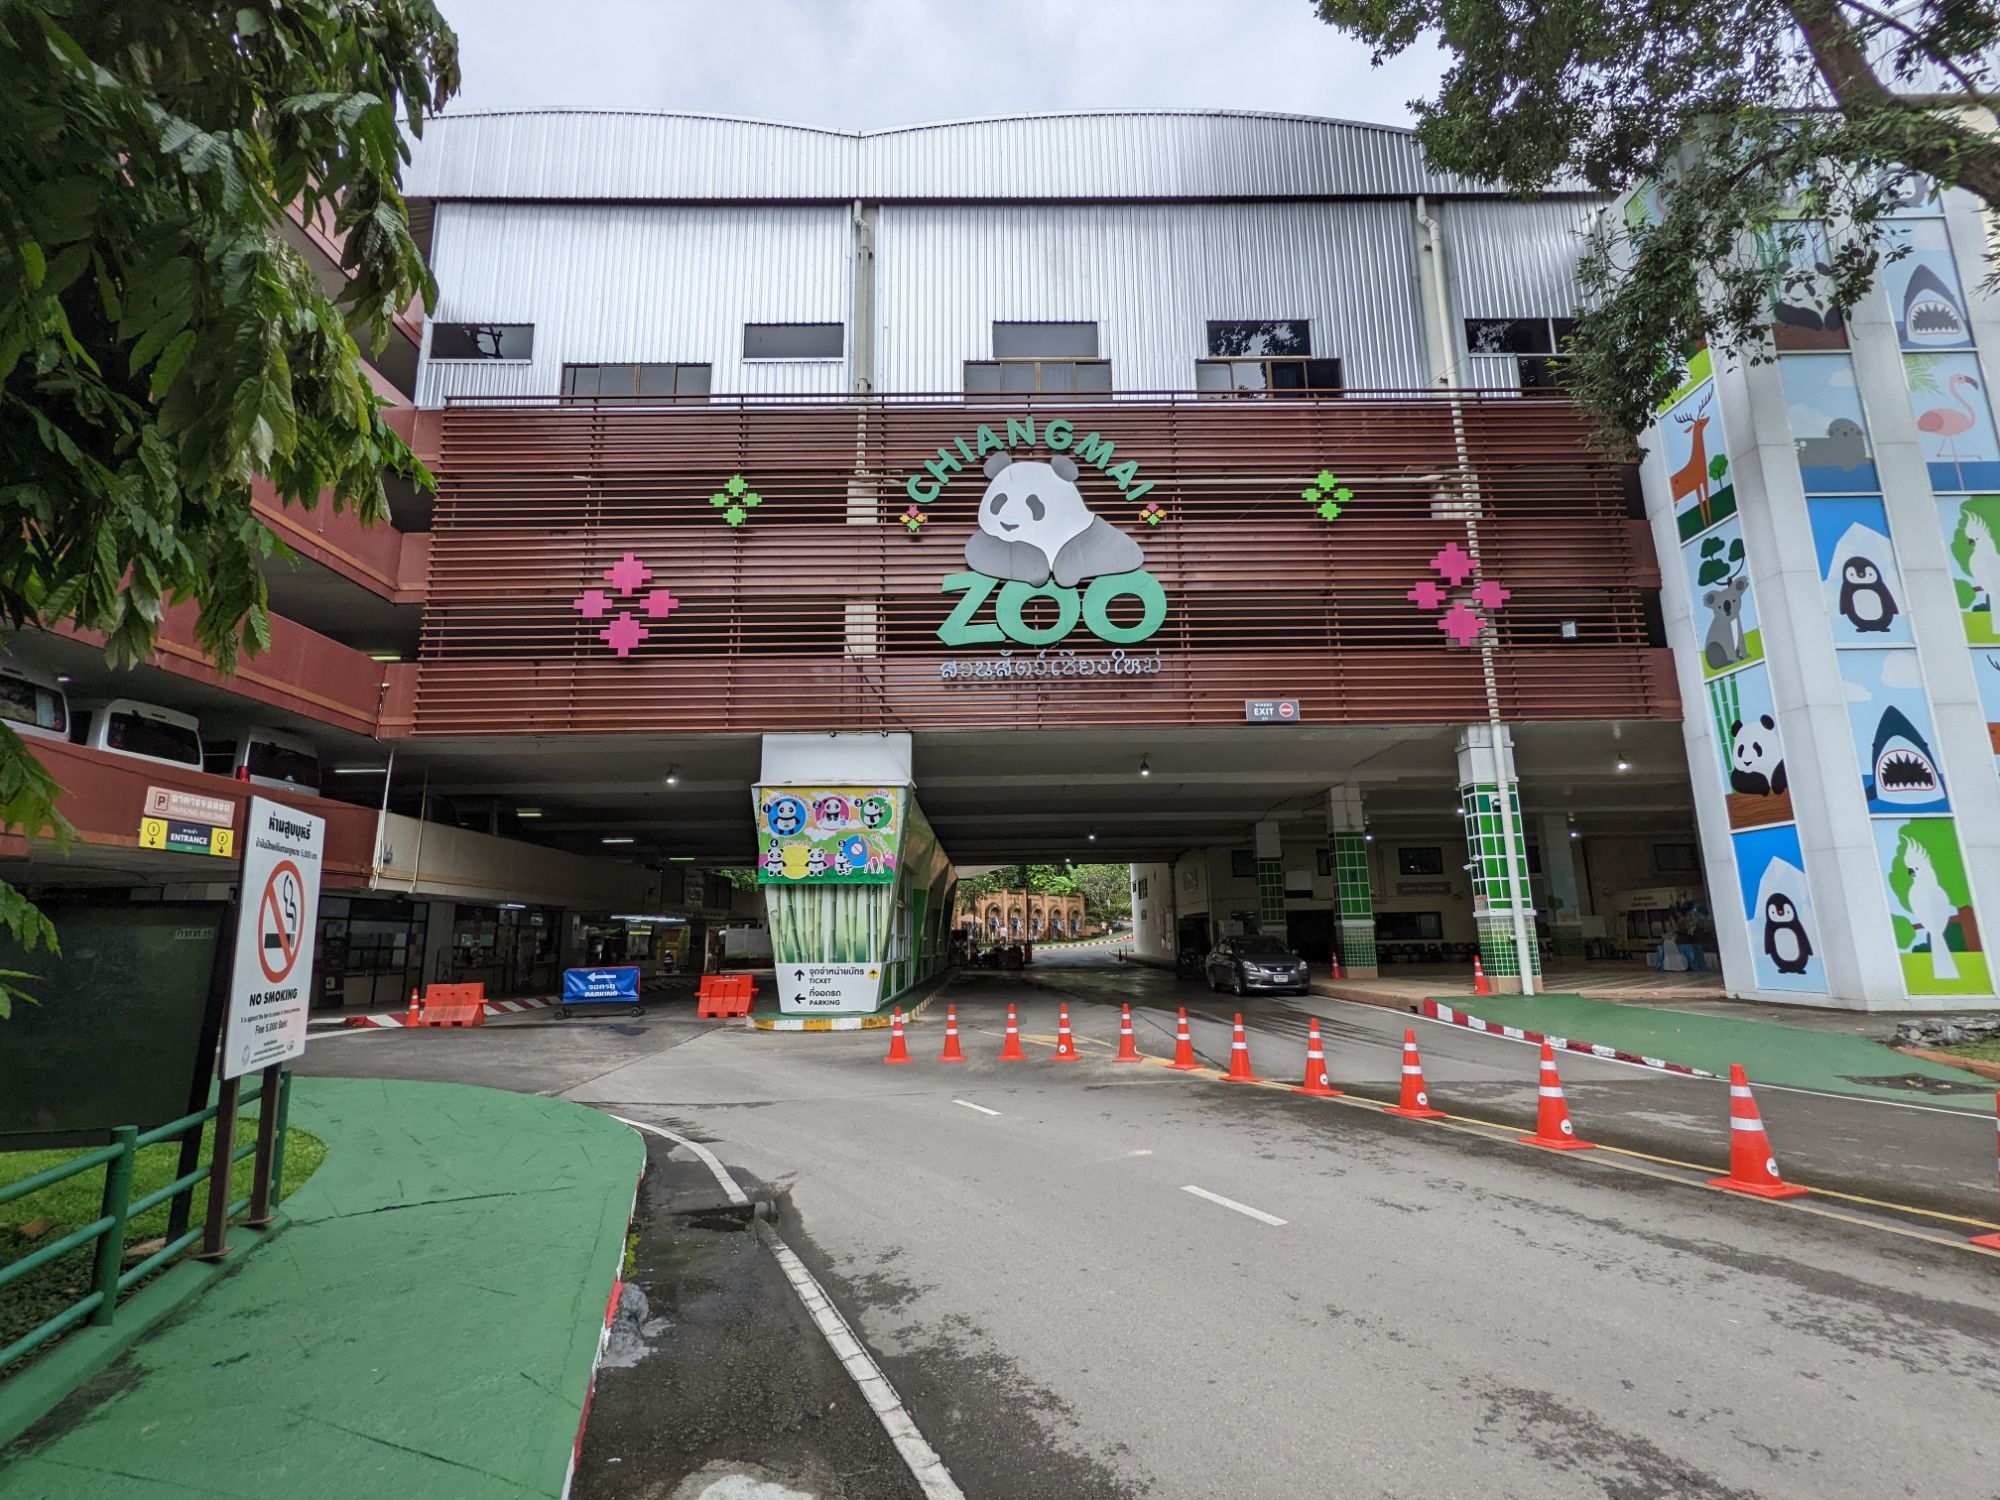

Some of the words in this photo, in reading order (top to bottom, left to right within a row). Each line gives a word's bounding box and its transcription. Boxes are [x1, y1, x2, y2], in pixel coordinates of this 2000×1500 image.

[906, 416, 1155, 503] CHIANGMAI
[936, 569, 1168, 647] ZOO
[939, 648, 1163, 679] สวนสัตว์เชียงใหม่
[1254, 707, 1274, 716] EXIT
[158, 795, 166, 807] P
[268, 810, 312, 842] ห้ามสูบบุหรี่
[170, 833, 208, 845] ENTRANCE
[809, 966, 865, 977] จุดจำหน่ายบัตร
[249, 993, 262, 1007] NO
[263, 988, 298, 1005] SMOKING
[584, 990, 619, 998] PARKING
[808, 986, 841, 997] ที่จอดรถ
[255, 1024, 264, 1035] Fine
